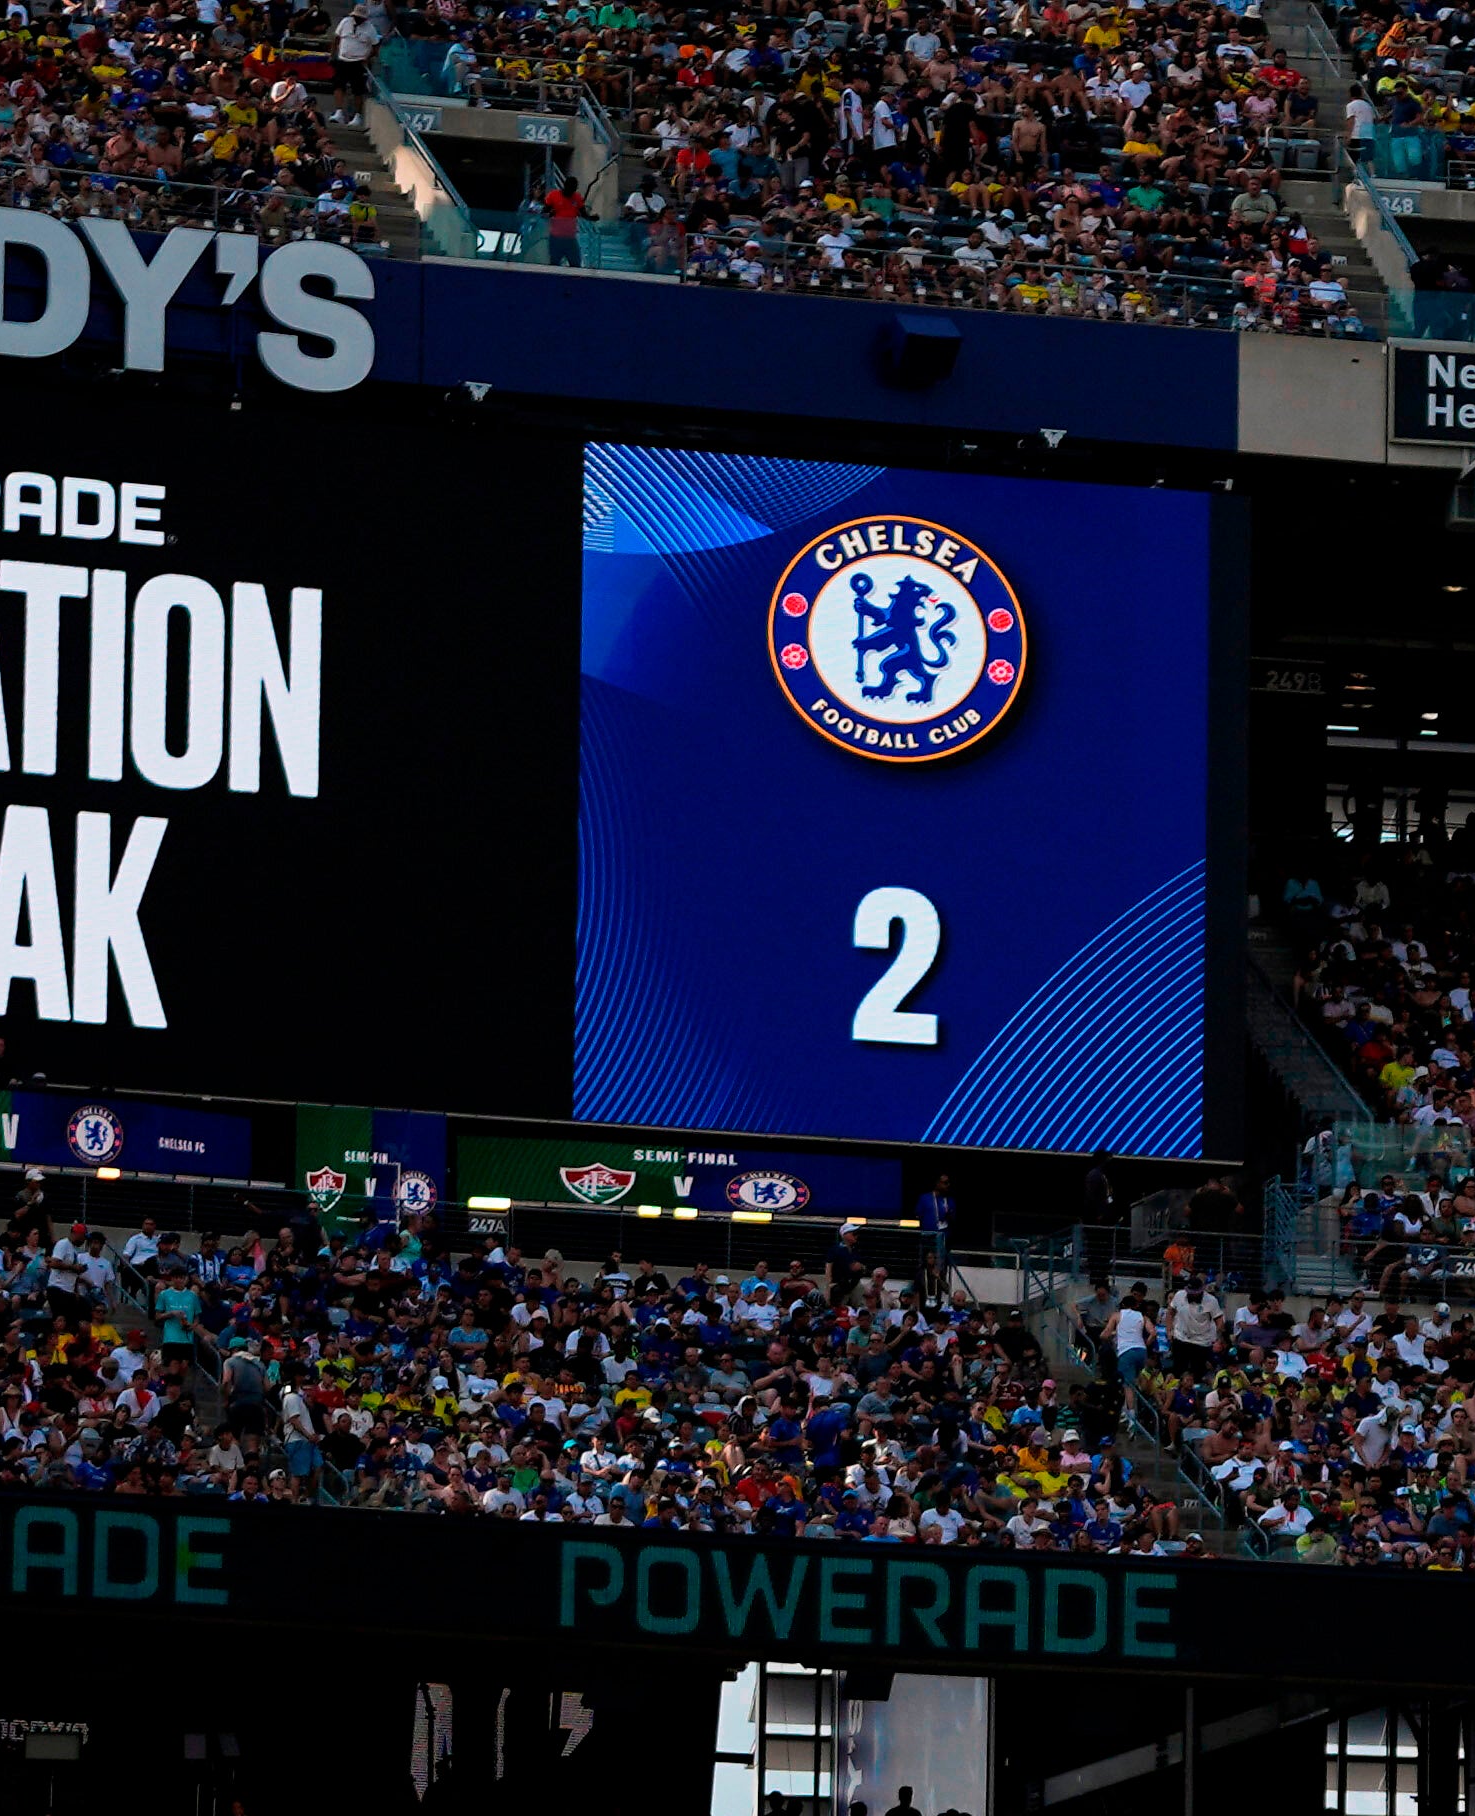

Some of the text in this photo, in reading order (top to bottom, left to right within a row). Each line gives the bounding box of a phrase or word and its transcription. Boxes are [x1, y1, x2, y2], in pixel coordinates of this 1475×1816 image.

[525, 123, 560, 142] 348
[815, 515, 982, 587] CHELSEA
[810, 694, 985, 753] FOOTBALL CLUB
[851, 886, 941, 1046] 2
[1, 1113, 20, 1150] V
[158, 1136, 206, 1155] CHELSEA FC
[344, 1150, 389, 1165] SEMI-FIN
[632, 1149, 738, 1167] SEMI-FINAL
[364, 1177, 377, 1198] V
[673, 1175, 694, 1197] V
[468, 1218, 507, 1233] 247A
[561, 1540, 1179, 1658] POWERADE
